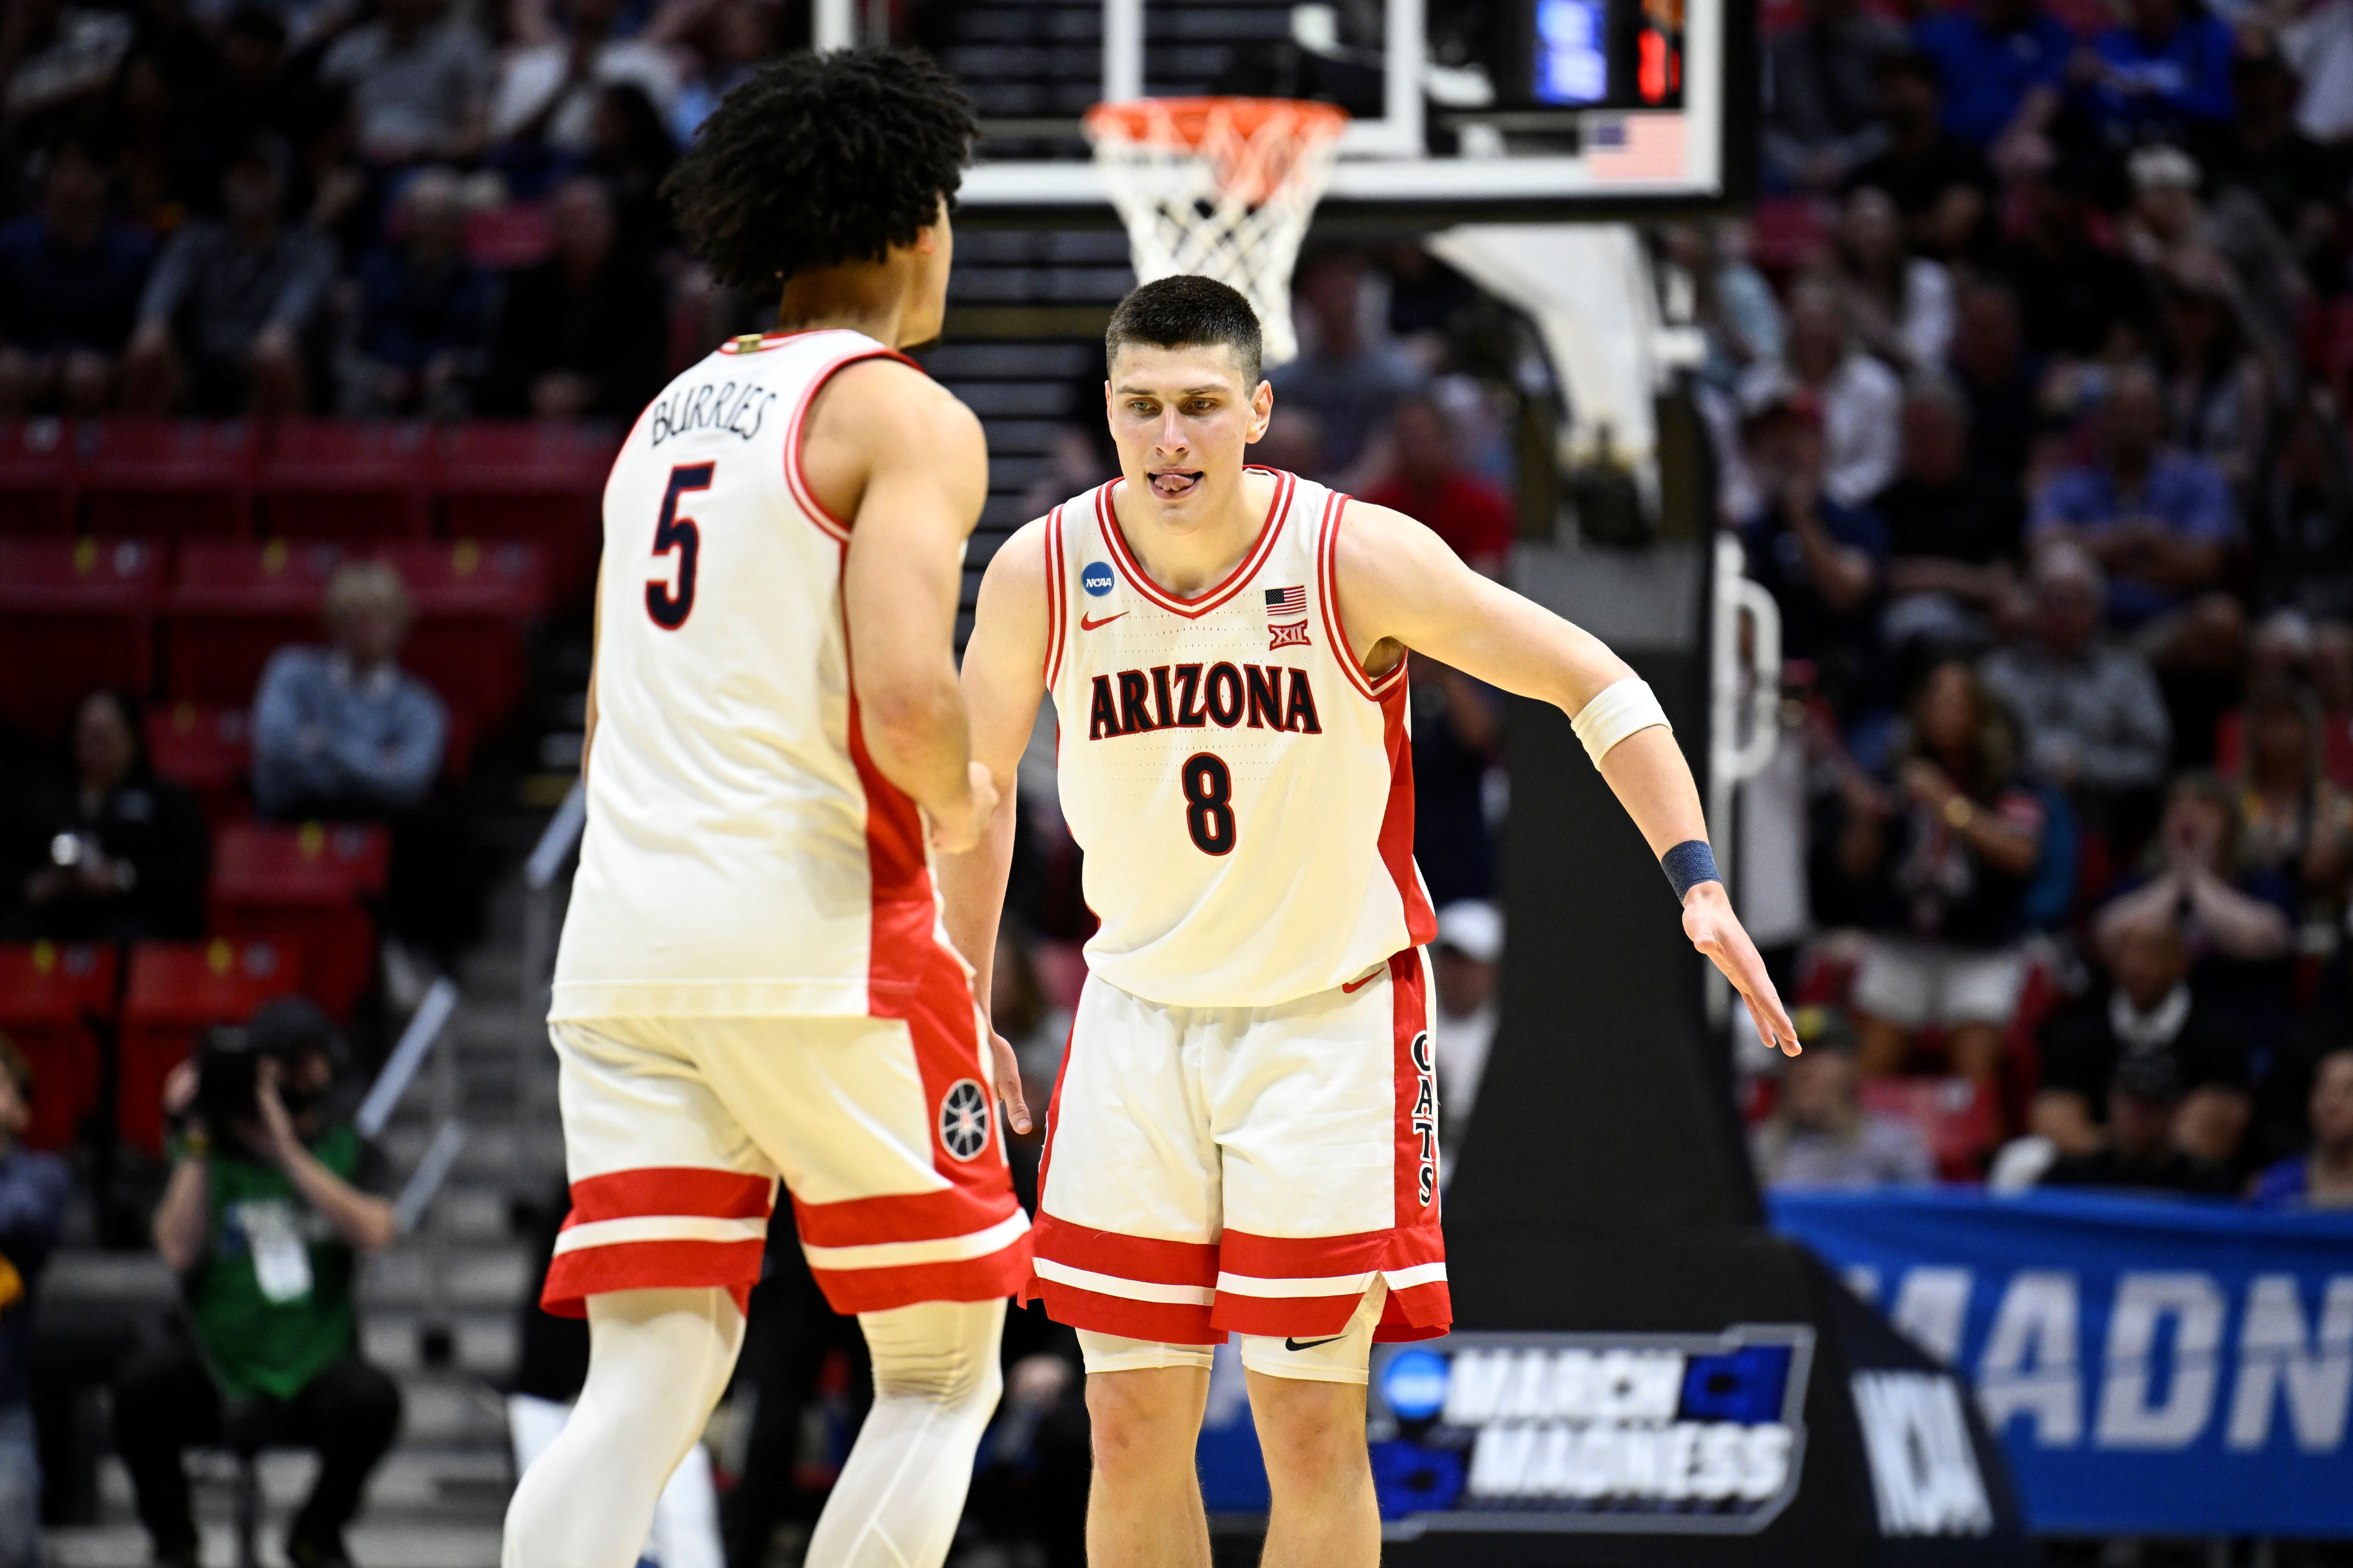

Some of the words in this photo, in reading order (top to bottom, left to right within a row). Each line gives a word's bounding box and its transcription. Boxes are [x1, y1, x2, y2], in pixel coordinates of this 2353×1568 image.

[652, 382, 776, 447] BURRIES
[645, 461, 716, 631] 5
[1086, 577, 1111, 587] NCAA
[1271, 623, 1308, 647] XII
[1089, 661, 1322, 741] ARIZONA
[1181, 752, 1236, 856] 8
[1411, 1030, 1434, 1208] CATS
